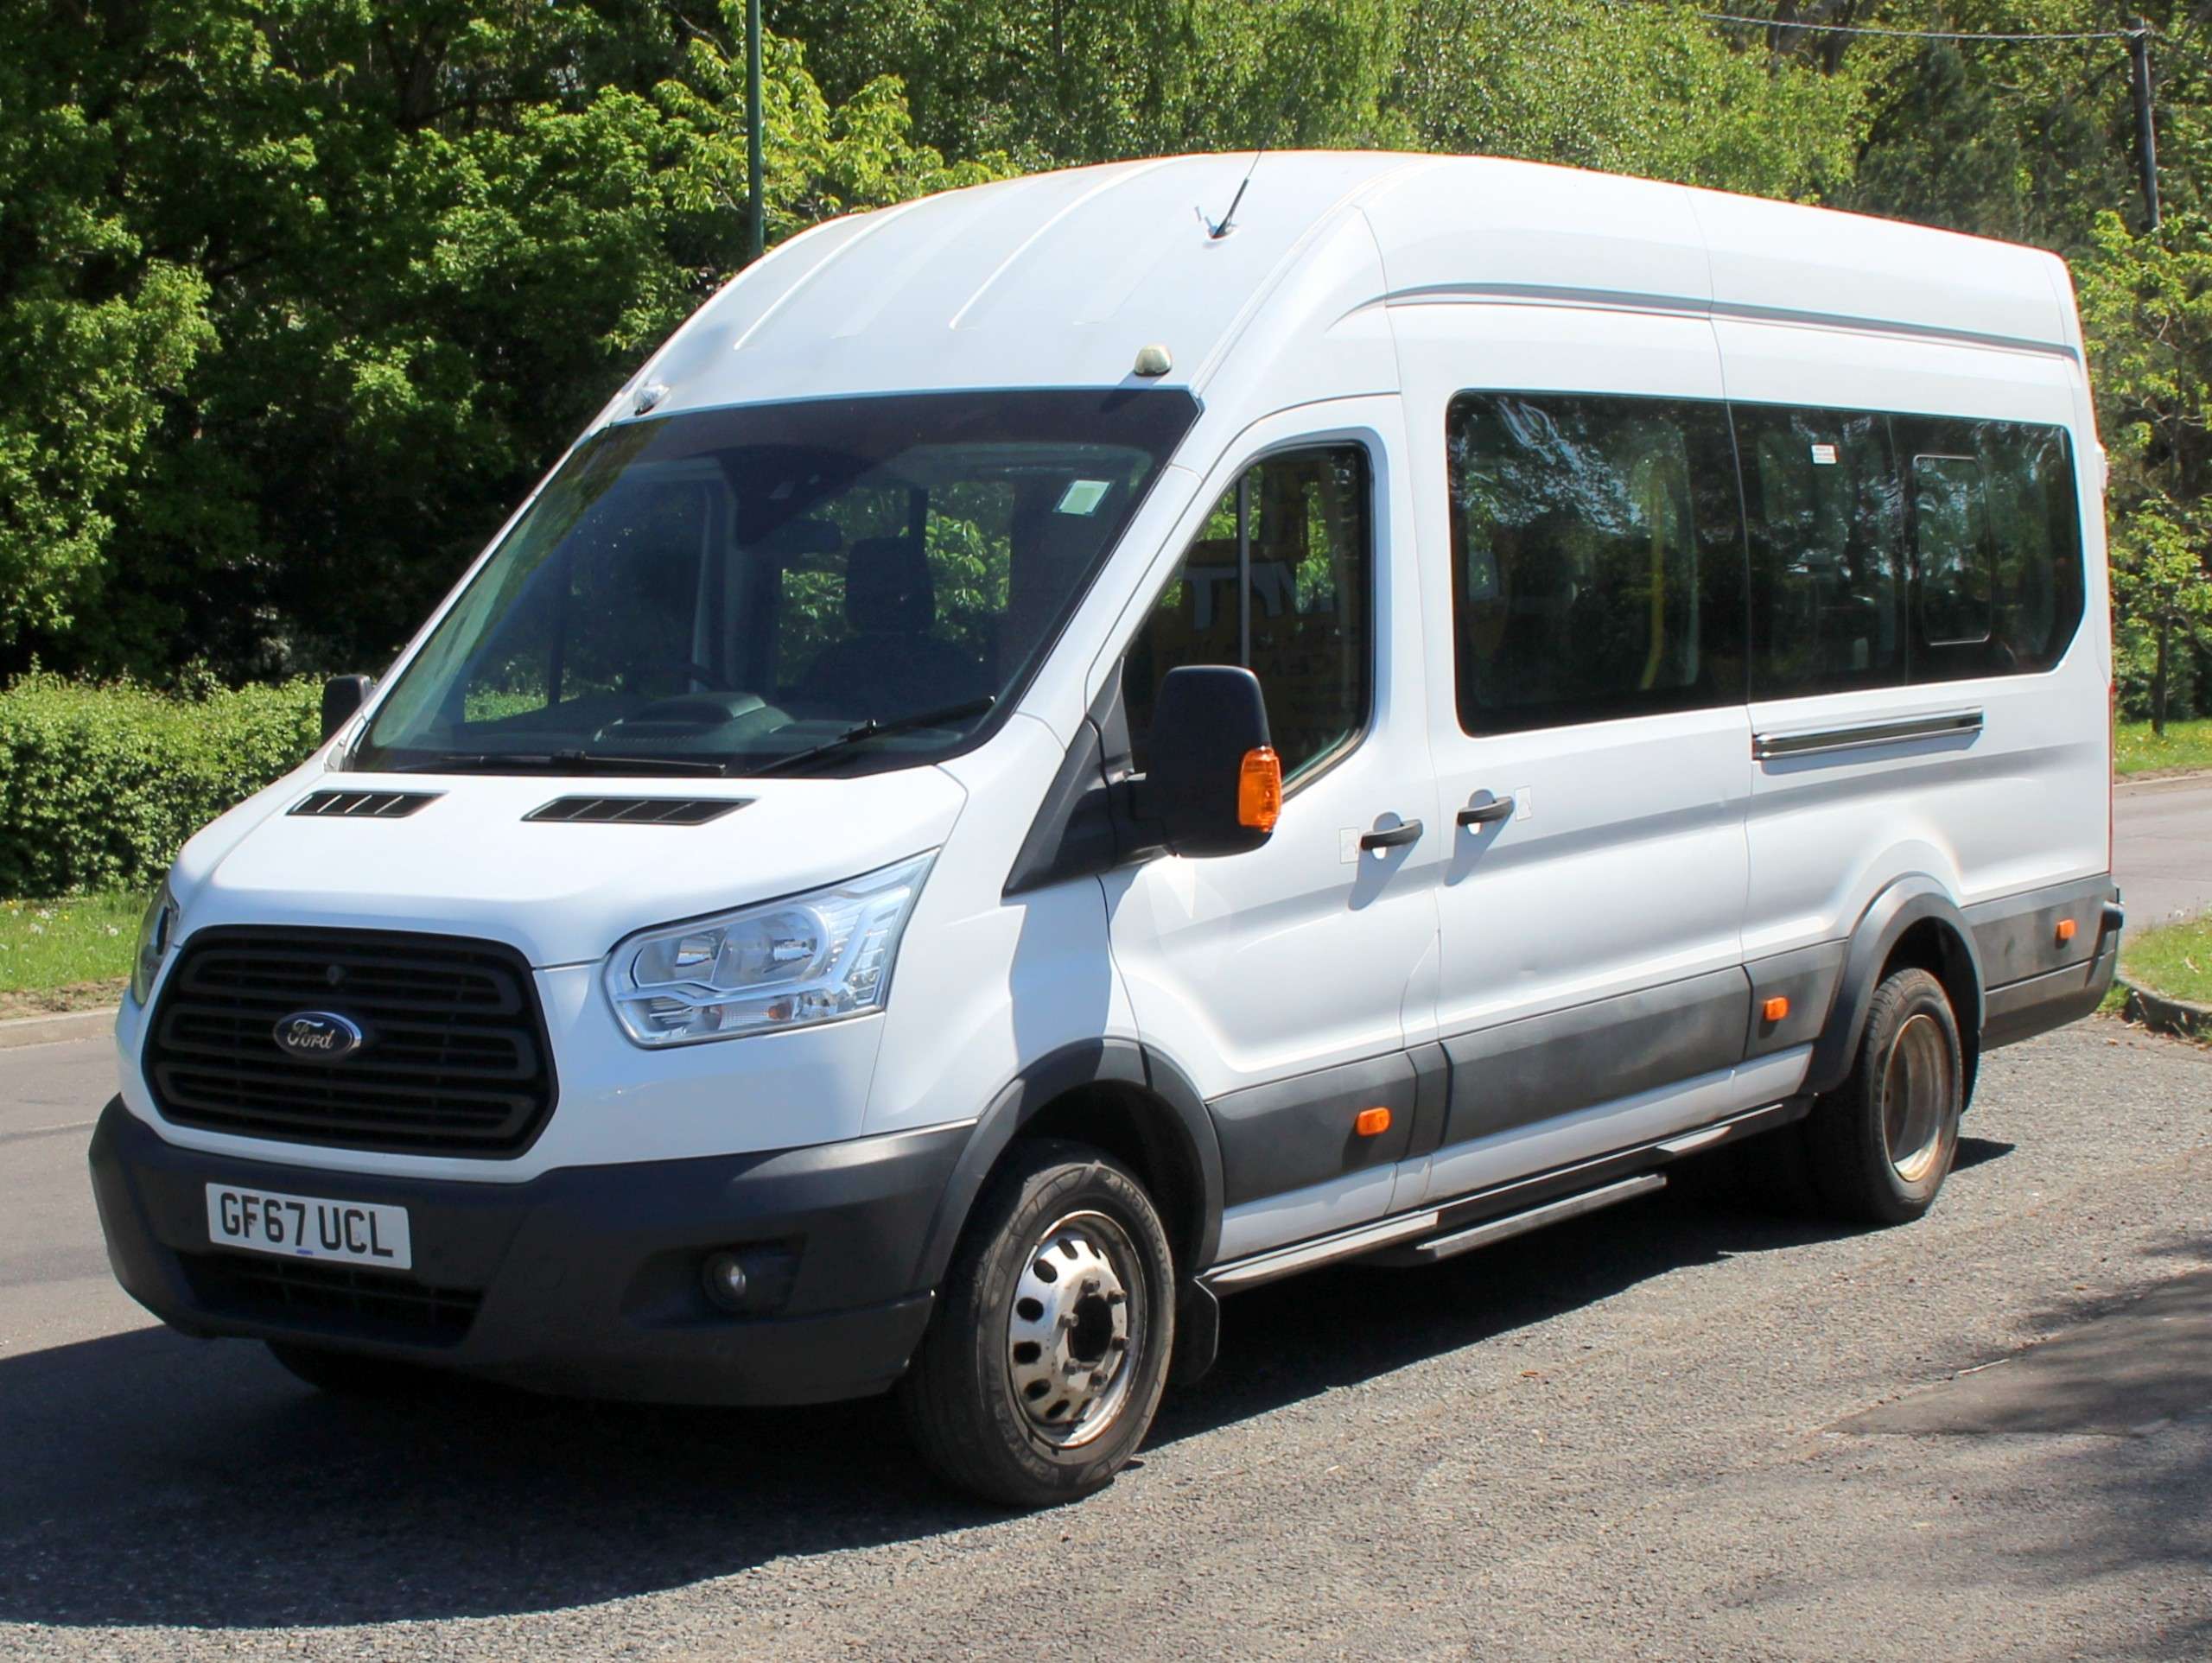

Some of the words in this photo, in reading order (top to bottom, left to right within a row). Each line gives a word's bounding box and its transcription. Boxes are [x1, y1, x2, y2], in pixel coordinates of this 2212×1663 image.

[287, 1019, 335, 1050] Ford
[220, 1192, 305, 1247] GF67
[318, 1205, 394, 1258] UCL
